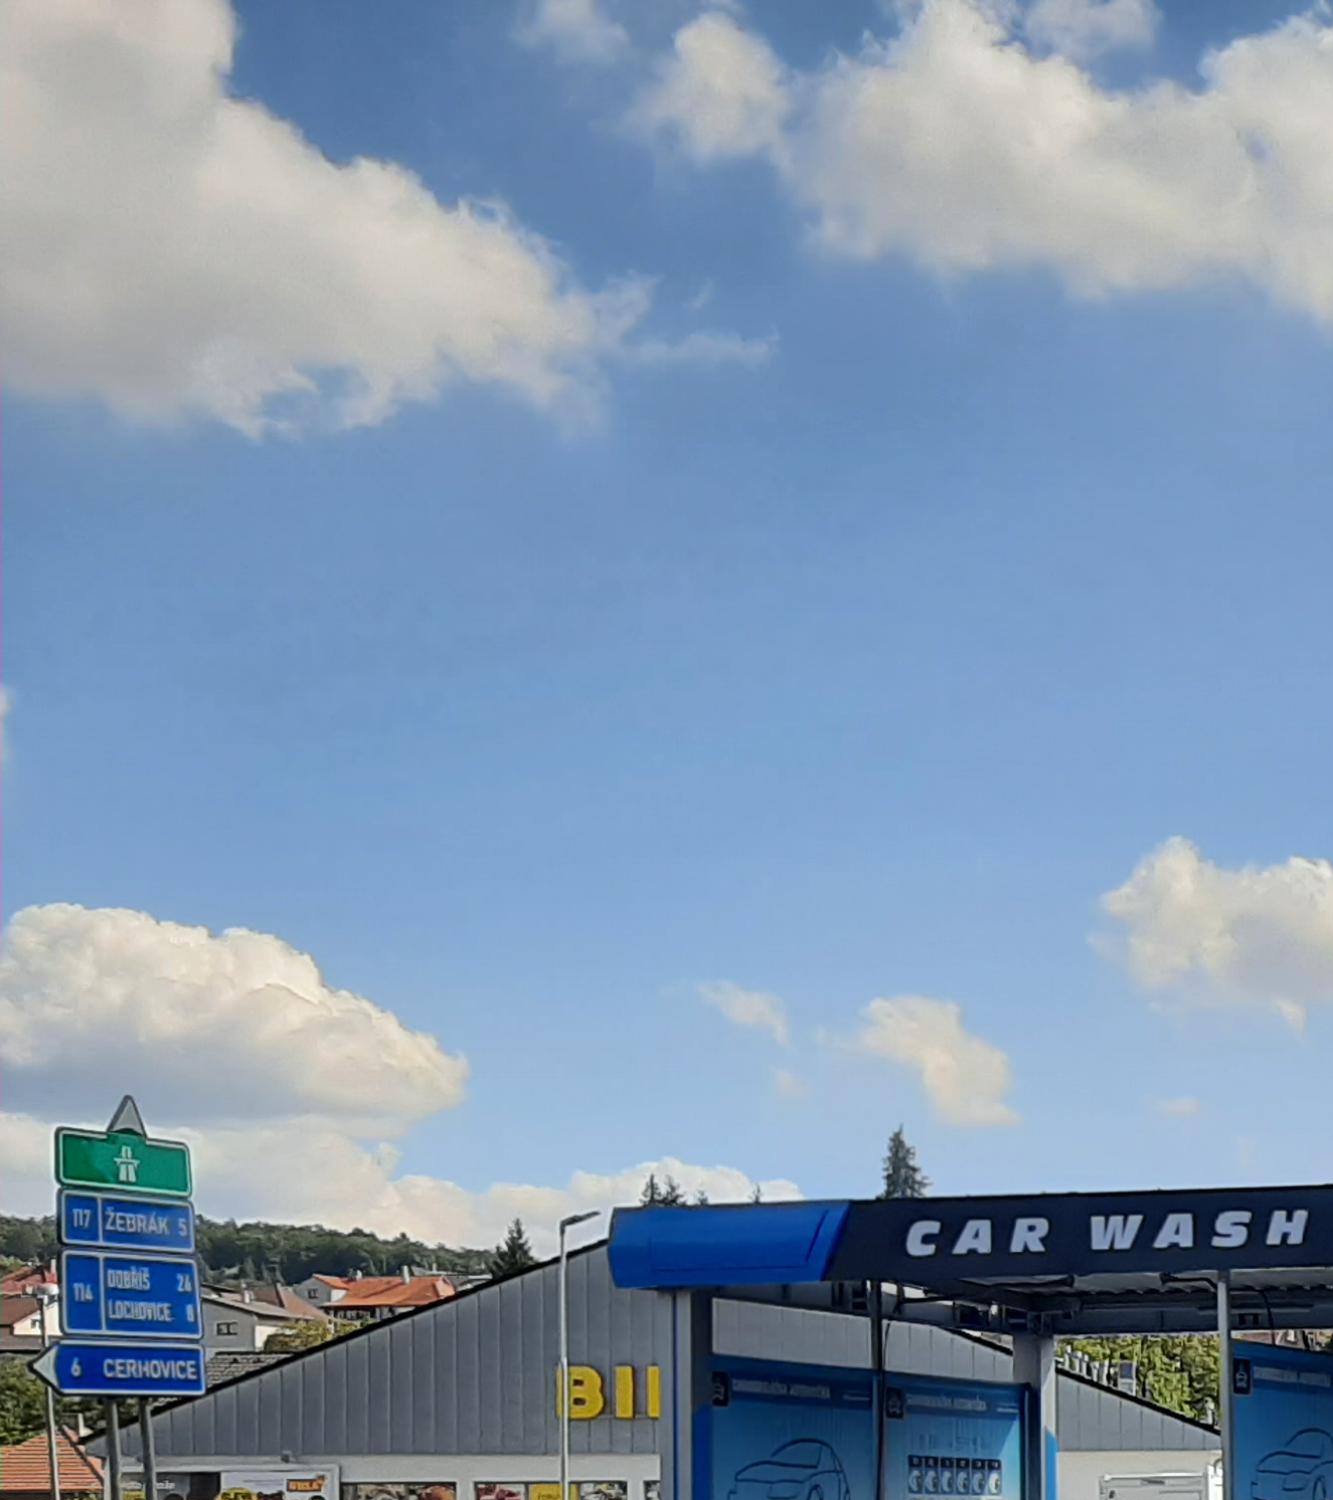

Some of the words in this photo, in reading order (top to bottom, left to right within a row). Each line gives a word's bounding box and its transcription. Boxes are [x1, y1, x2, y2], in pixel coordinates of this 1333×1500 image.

[72, 1207, 91, 1229] 117
[104, 1206, 169, 1236] ŽEBRÁK
[178, 1218, 188, 1238] 5
[904, 1217, 1050, 1258] CAR
[1089, 1208, 1308, 1252] WASH
[107, 1266, 151, 1291] DOBŘÍŠ
[108, 1299, 173, 1323] LOCHOVICE
[70, 1357, 82, 1378] 6
[103, 1358, 198, 1380] CERHOVICE
